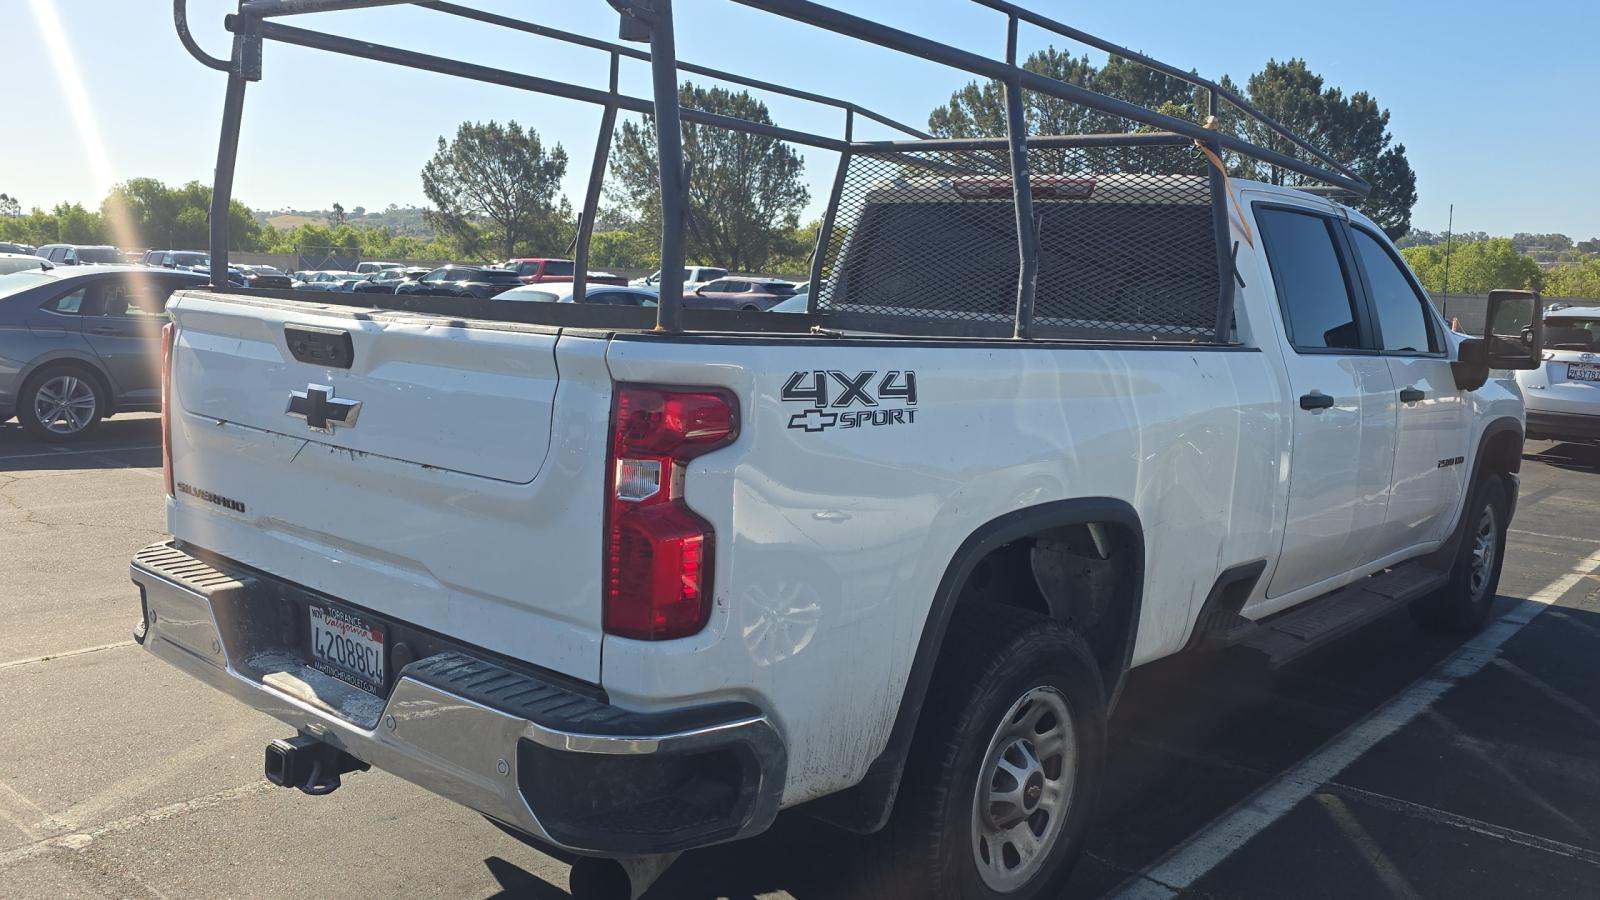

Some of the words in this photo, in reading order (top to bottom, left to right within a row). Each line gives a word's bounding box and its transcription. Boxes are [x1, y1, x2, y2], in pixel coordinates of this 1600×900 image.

[781, 369, 918, 408] 4X4
[839, 408, 919, 429] SPORT
[324, 616, 370, 638] California
[327, 608, 363, 629] TORRANCE
[315, 626, 384, 684] 42088C4
